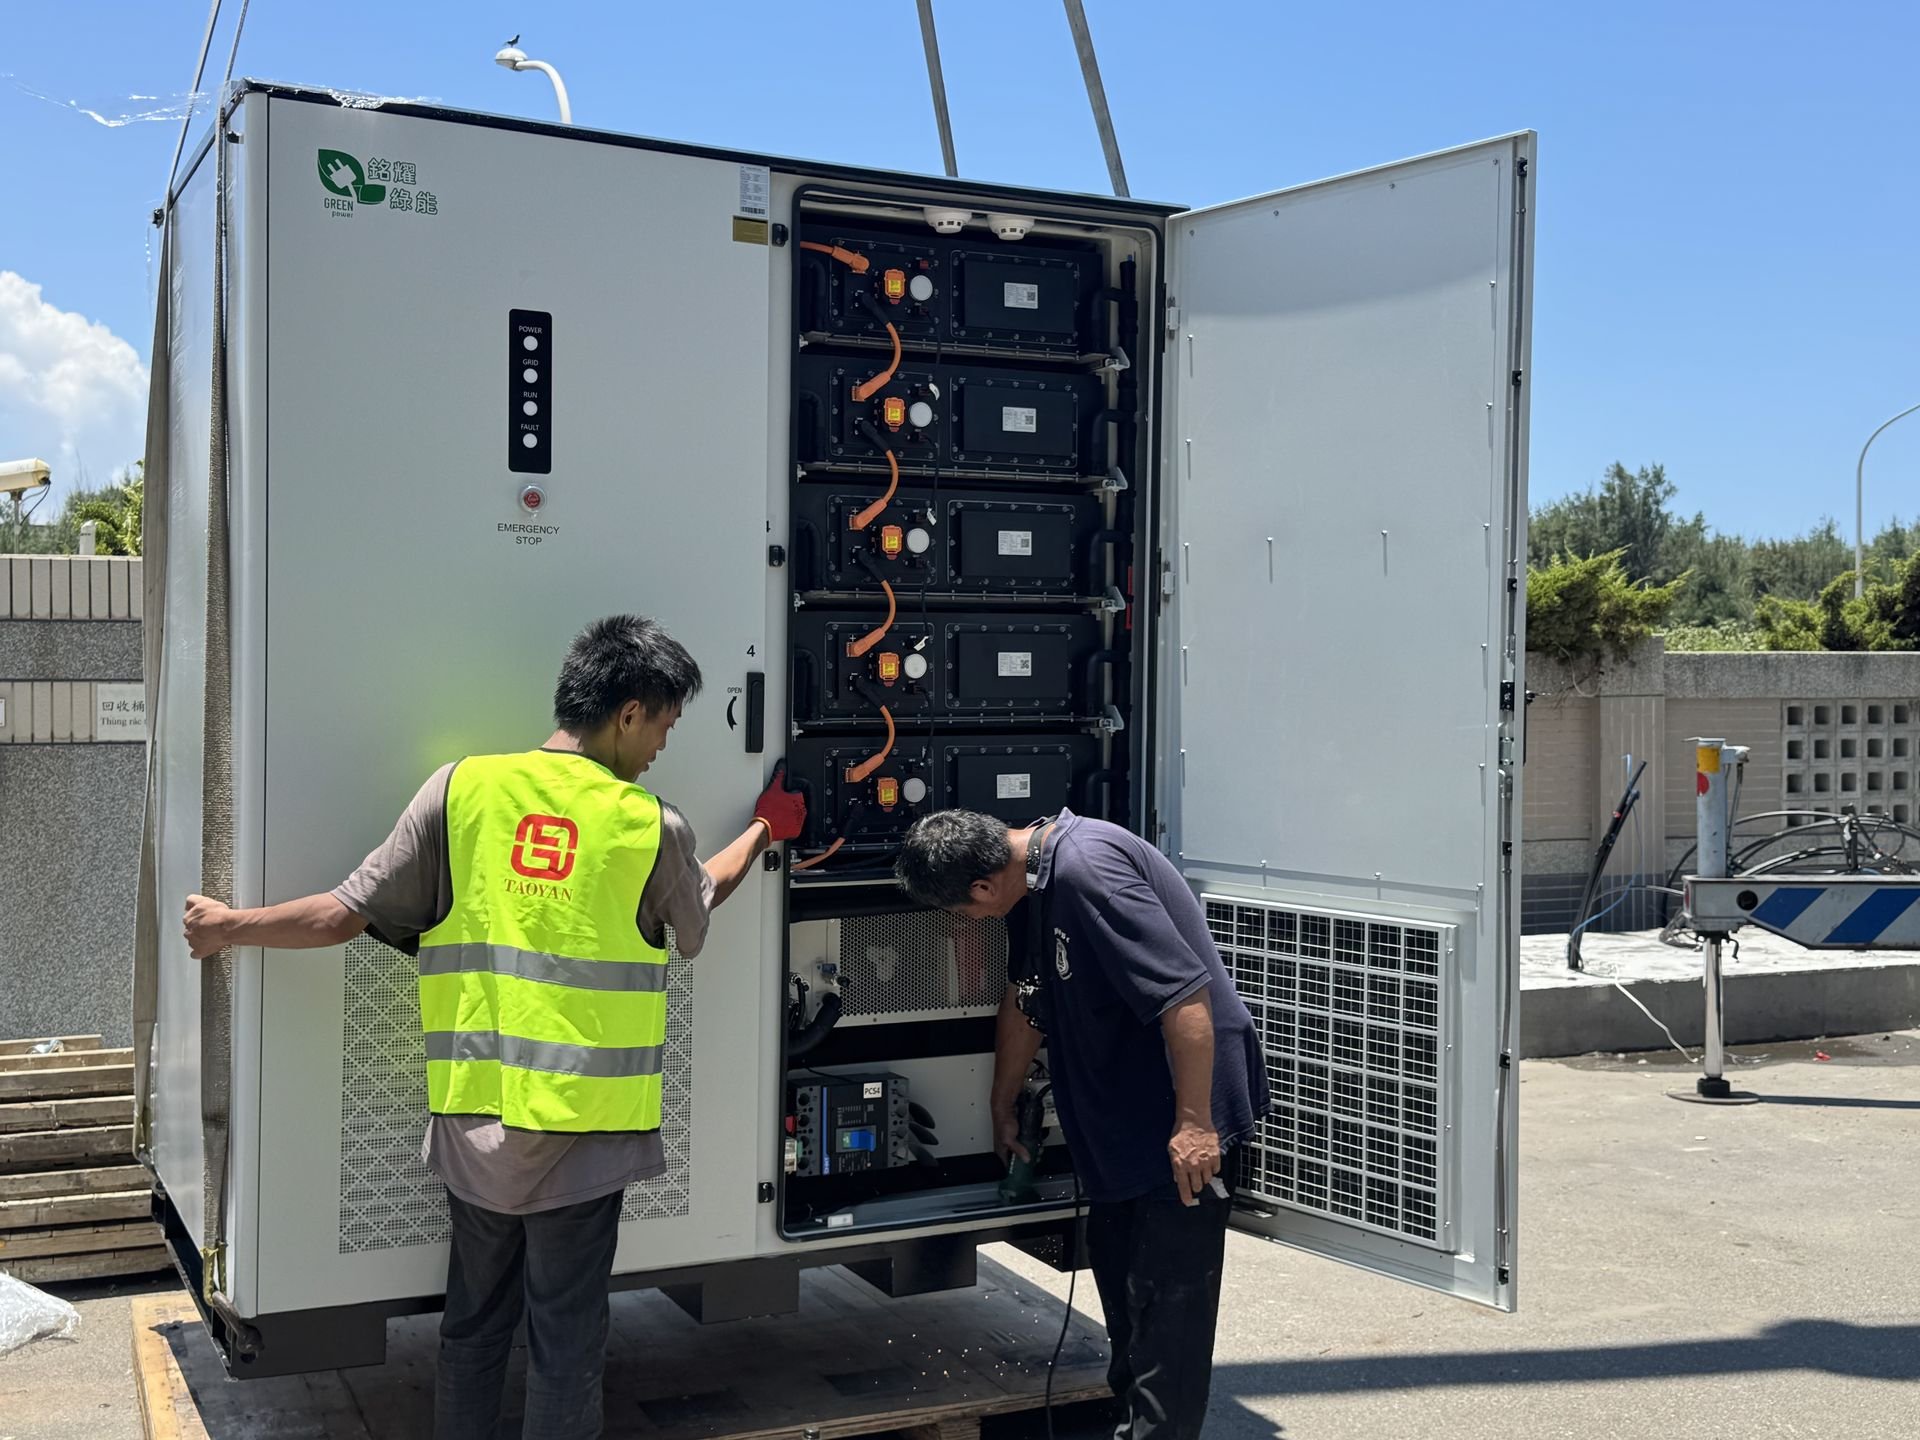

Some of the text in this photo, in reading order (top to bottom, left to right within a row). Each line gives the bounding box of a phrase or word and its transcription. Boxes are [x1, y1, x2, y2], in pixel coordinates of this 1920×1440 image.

[368, 157, 416, 185] 銘耀
[324, 197, 353, 211] GREEN
[390, 188, 438, 215] 綠能
[331, 210, 353, 218] power
[518, 325, 543, 334] POWER
[522, 358, 539, 366] GRID
[520, 423, 540, 431] FAULT
[497, 522, 560, 535] EMERGENCY
[515, 535, 543, 546] STOP
[746, 644, 756, 657] 4
[727, 686, 742, 694] OPEN
[102, 700, 145, 712] 回收桶
[504, 878, 574, 902] TAOYAN
[864, 1087, 881, 1095] PCS4
